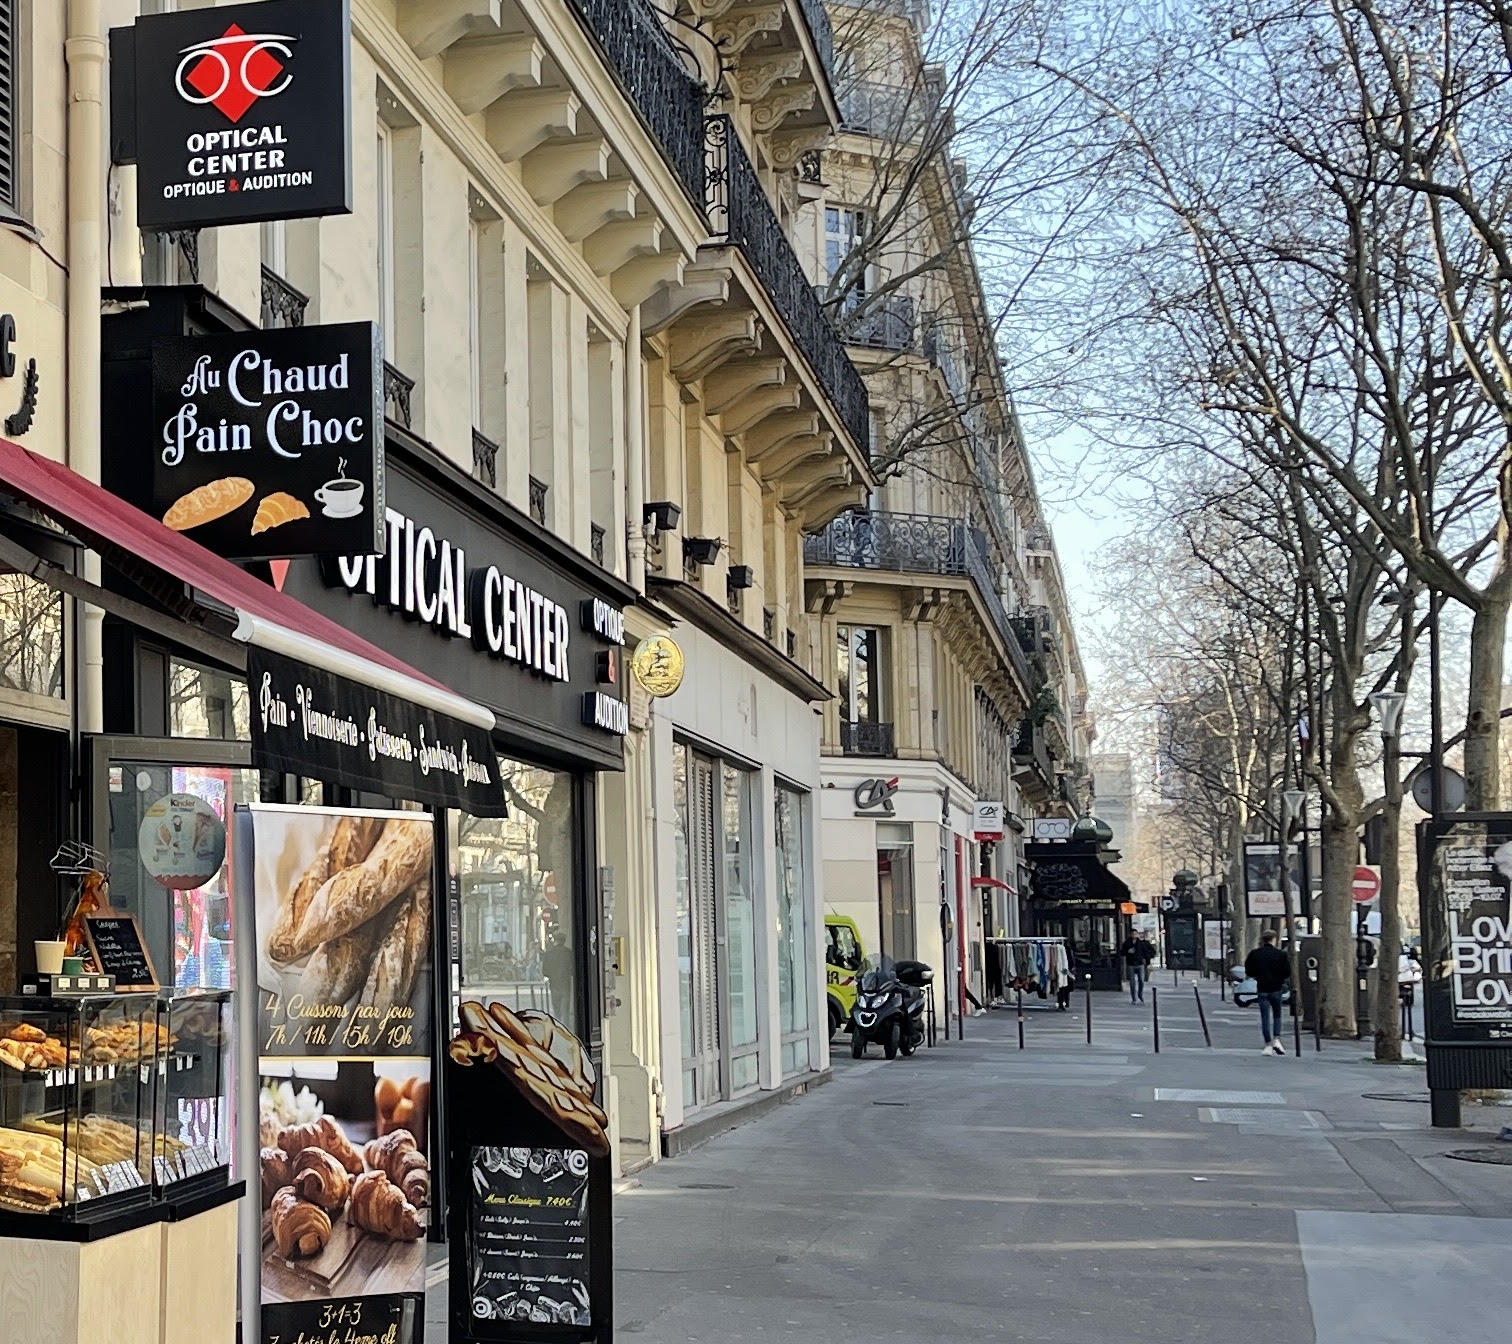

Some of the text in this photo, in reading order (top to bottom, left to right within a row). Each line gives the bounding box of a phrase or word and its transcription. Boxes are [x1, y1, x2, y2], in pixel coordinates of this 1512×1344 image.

[187, 125, 287, 153] OPTICAL
[188, 149, 285, 177] CENTER
[163, 171, 313, 199] OPTIQUE & AUDITION
[181, 349, 349, 407] Au Chaud
[161, 399, 364, 467] Pain Choc
[484, 564, 570, 683] CENTER
[593, 597, 626, 646] OPTIQUE
[260, 671, 288, 733] Pain
[295, 683, 358, 747] Viennoiserie
[419, 723, 459, 776] Sandwich
[594, 691, 629, 736] AUDITION
[265, 993, 415, 1030] 4 Cuissons par jour
[265, 1024, 287, 1051] 7h
[304, 1024, 327, 1046] 11h
[342, 1025, 370, 1049] 15h
[387, 1024, 414, 1049] 19h
[319, 1302, 363, 1328] 3+1=3
